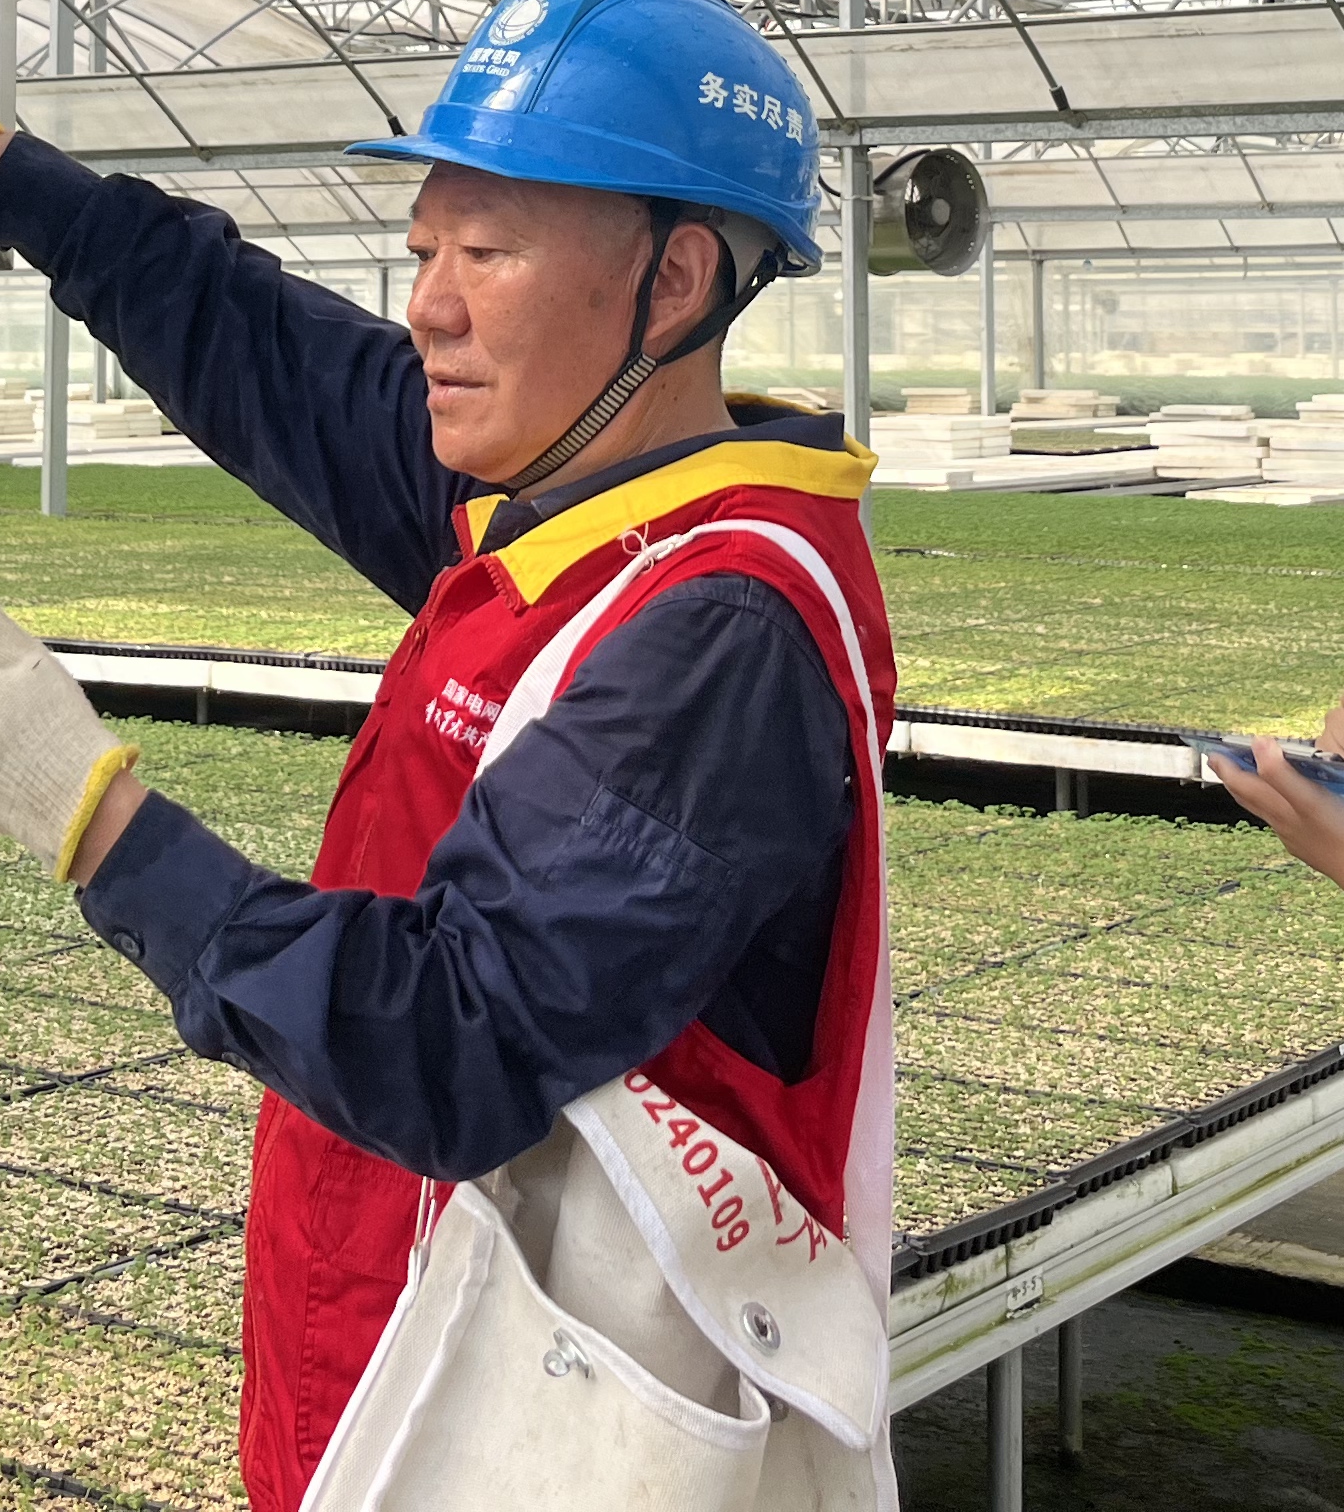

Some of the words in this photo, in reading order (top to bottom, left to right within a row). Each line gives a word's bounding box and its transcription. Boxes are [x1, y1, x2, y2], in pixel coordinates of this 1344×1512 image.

[467, 47, 521, 67] 国家电网
[698, 71, 804, 147] 务实尽责
[441, 677, 502, 723] 国家电网
